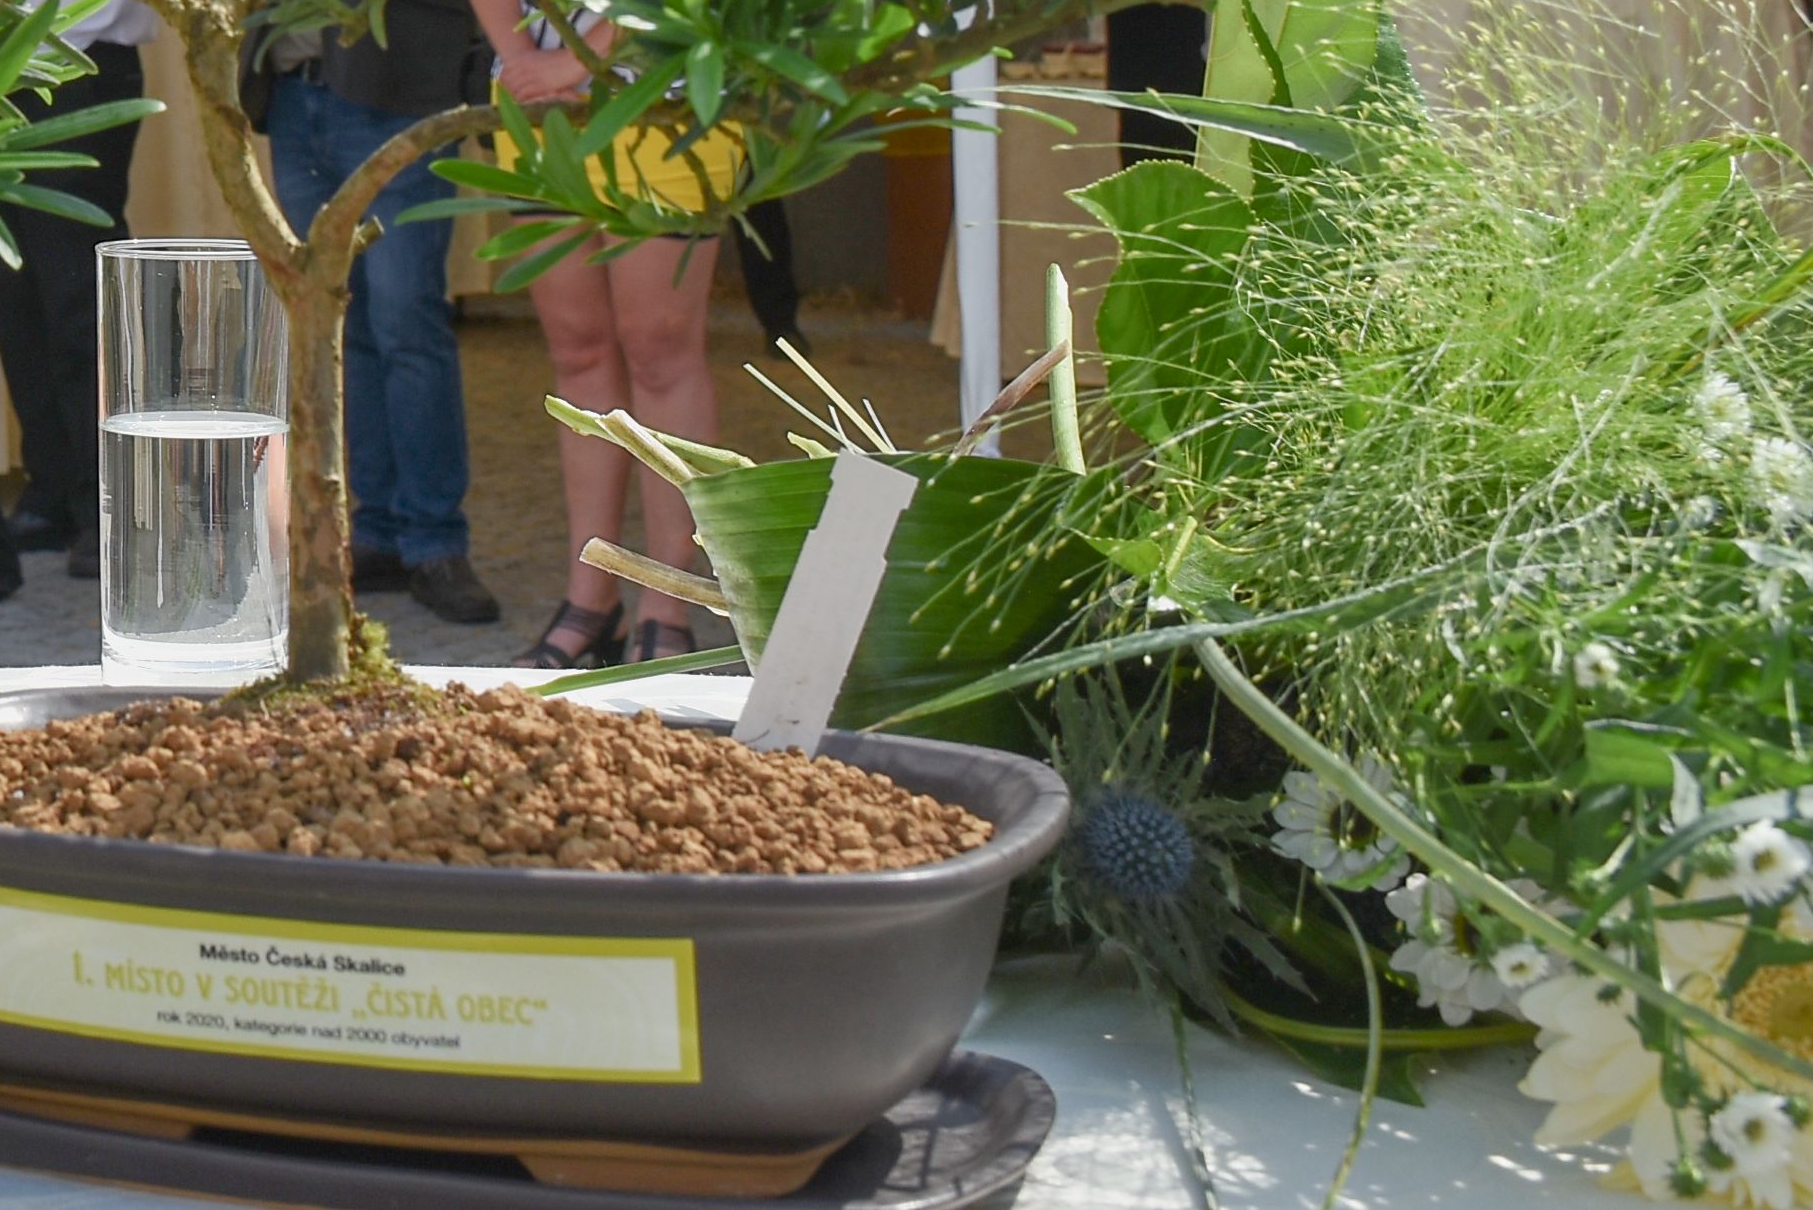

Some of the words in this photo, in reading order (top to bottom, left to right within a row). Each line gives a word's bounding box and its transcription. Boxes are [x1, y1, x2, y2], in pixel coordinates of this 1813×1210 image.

[199, 943, 259, 964] Město
[265, 945, 328, 971] Česká
[334, 955, 406, 976] Skalice
[104, 958, 186, 998] MÍSTO
[195, 972, 213, 1002] V
[224, 974, 341, 1012] SOUTĚŽI
[157, 1009, 181, 1025] rok
[187, 1011, 229, 1031] 2020,
[233, 1016, 307, 1036] kategorie
[312, 1024, 341, 1039] nad
[346, 1026, 386, 1044] 2000
[390, 1031, 461, 1050] obyvatel
